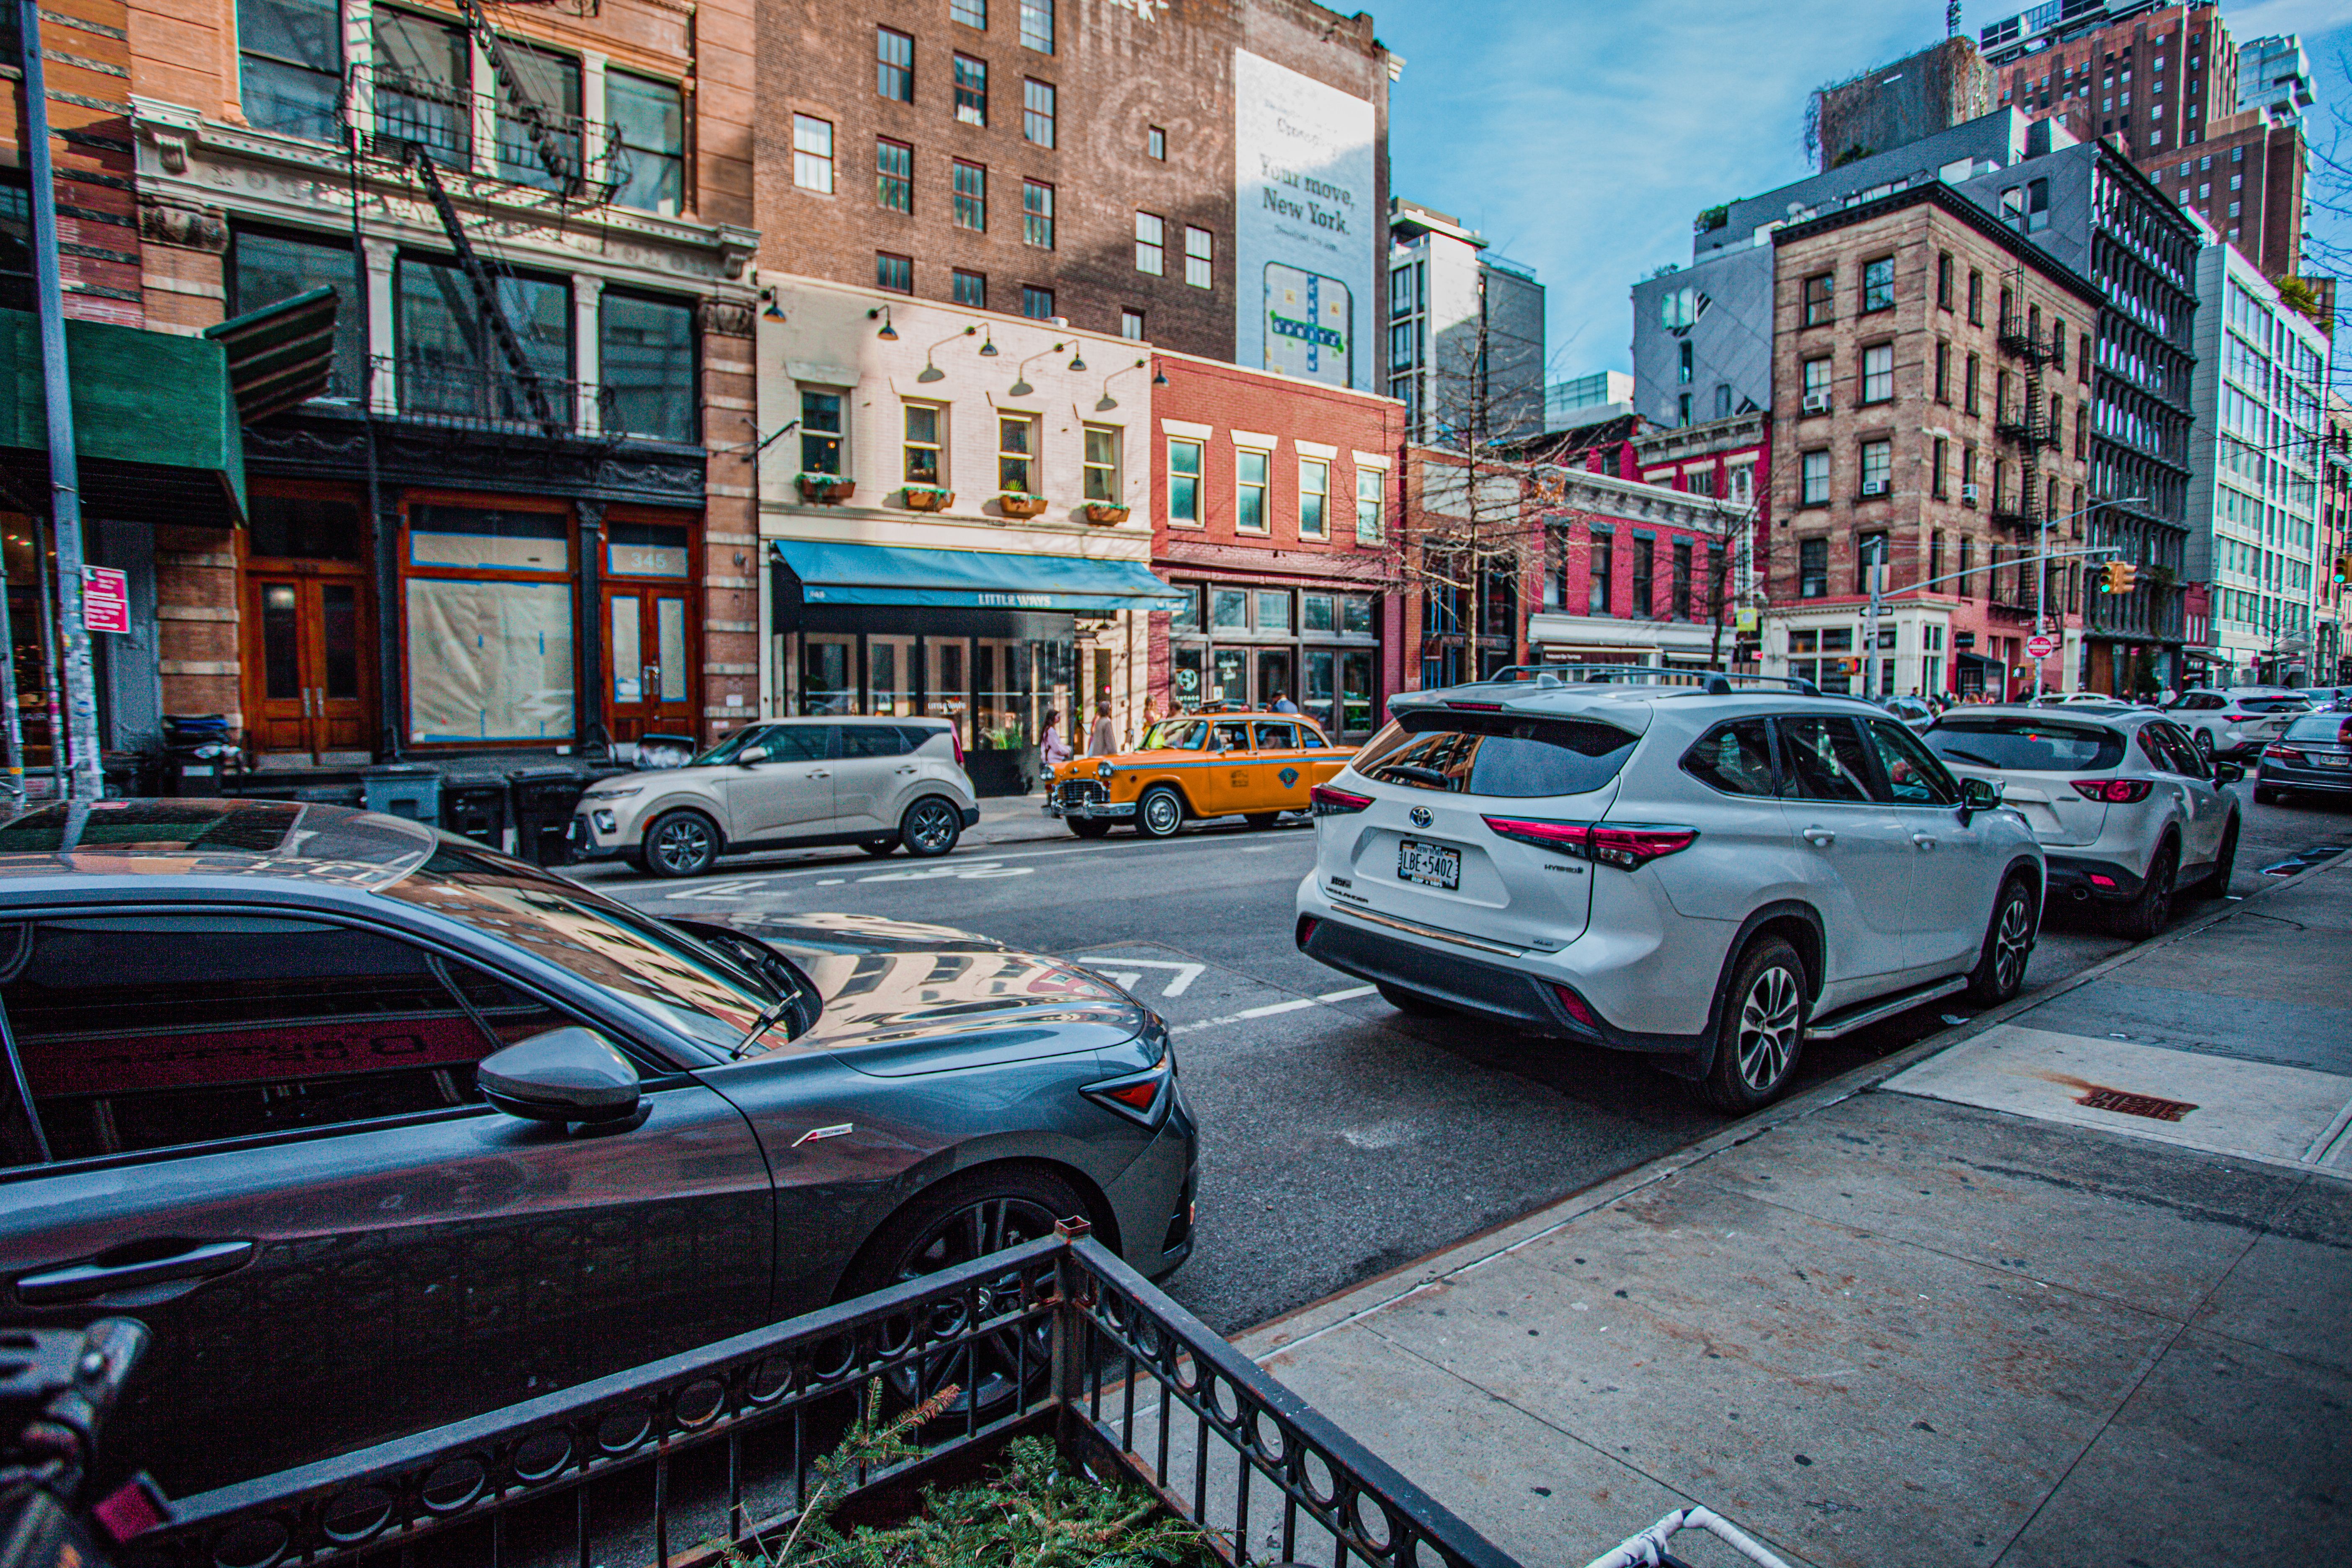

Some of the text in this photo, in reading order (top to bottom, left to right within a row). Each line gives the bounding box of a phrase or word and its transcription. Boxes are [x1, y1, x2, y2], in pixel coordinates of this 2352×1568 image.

[1259, 152, 1354, 211] Your move,
[1262, 186, 1351, 235] New York.
[630, 552, 666, 569] 345
[978, 593, 1052, 607] LITTLE WAYS
